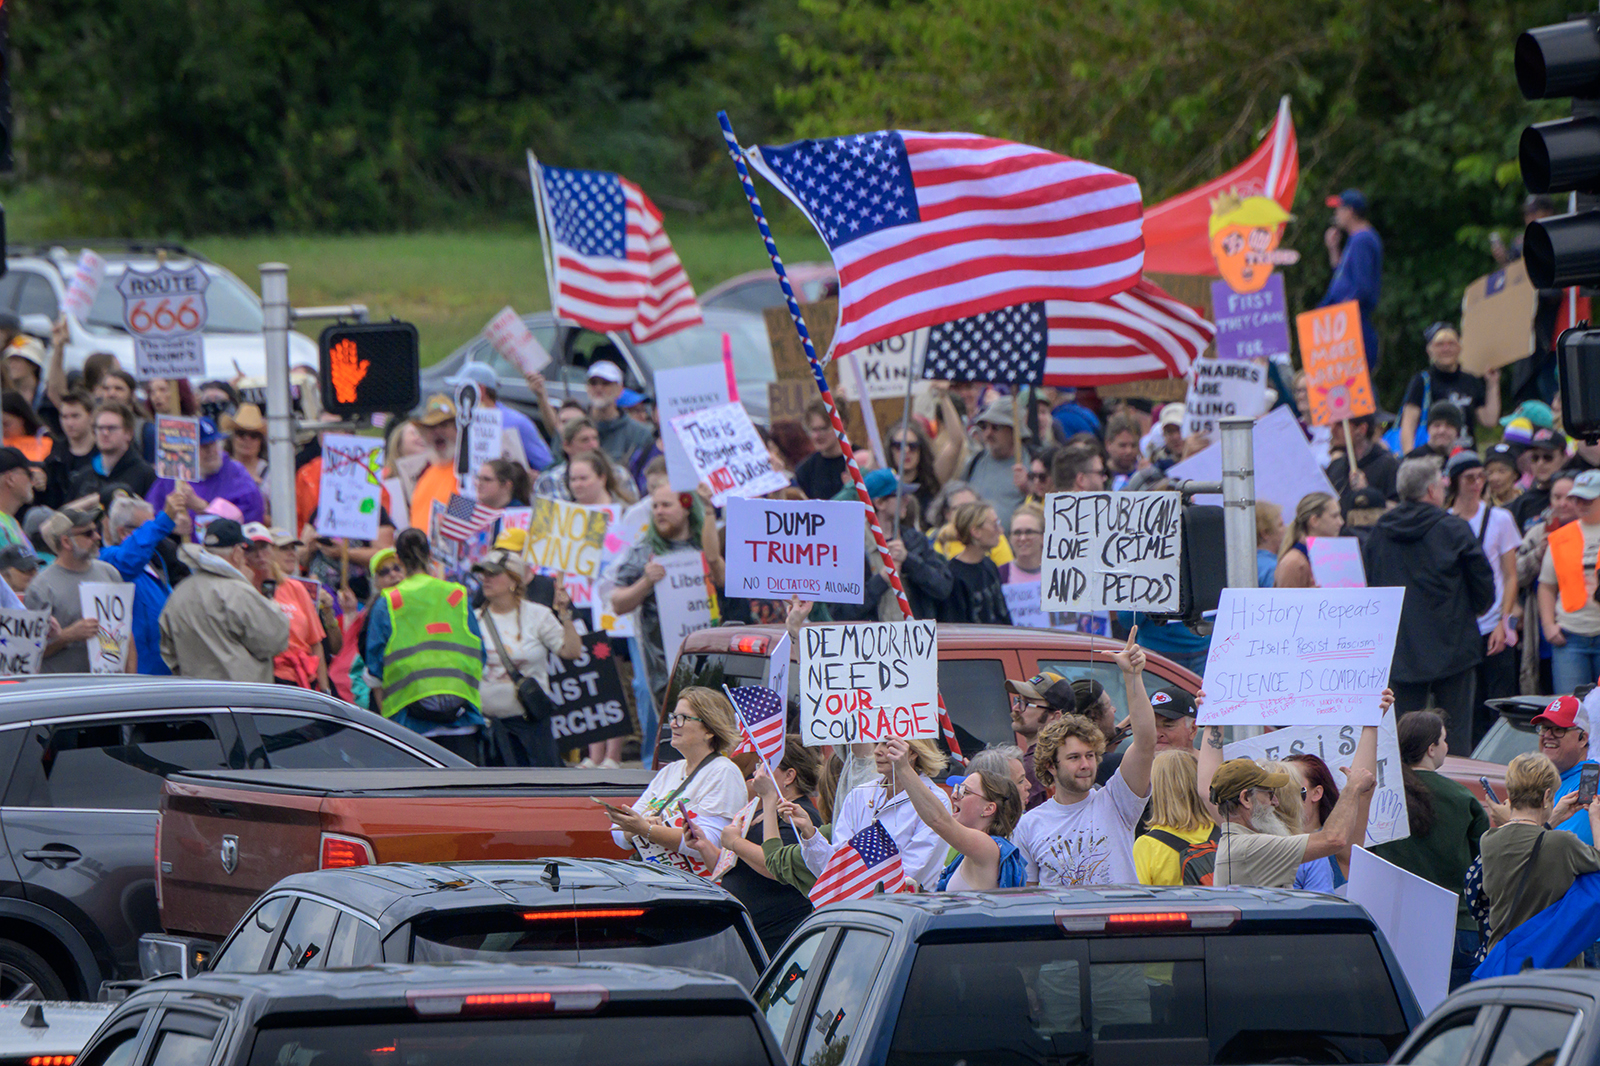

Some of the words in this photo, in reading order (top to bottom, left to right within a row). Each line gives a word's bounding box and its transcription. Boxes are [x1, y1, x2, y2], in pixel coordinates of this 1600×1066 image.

[131, 275, 198, 295] ROUTE
[130, 298, 200, 333] 666
[1228, 291, 1273, 313] FIRST
[1217, 315, 1250, 333] THEY
[1312, 310, 1347, 346] NO
[868, 333, 906, 354] NO
[1310, 338, 1356, 368] MORE
[1198, 363, 1259, 384] NAIRES
[683, 420, 719, 444] This
[1190, 420, 1213, 433] US
[694, 443, 737, 469] Straight
[738, 440, 755, 456] up
[708, 466, 735, 495] NAZI
[550, 502, 588, 541] NO
[764, 510, 826, 537] DUMP
[524, 529, 599, 576] KING
[744, 539, 838, 568] TRUMP!
[1046, 533, 1090, 561] LOVE
[1101, 532, 1175, 568] CRIME
[743, 576, 760, 590] NO
[767, 576, 820, 592] DICTATORS
[824, 580, 861, 596] ALLOWED
[1047, 566, 1087, 605] AND
[1102, 573, 1177, 606] PEDOS
[94, 595, 125, 622] NO
[687, 598, 714, 612] and
[1231, 597, 1304, 637] History
[1318, 599, 1381, 629] Repeats
[806, 623, 936, 660] DEMOCRACY
[1295, 637, 1328, 655] Resist
[550, 672, 600, 706] NST
[808, 659, 909, 691] NEEDS
[1213, 671, 1289, 702] SILENCE
[1298, 669, 1314, 692] IS
[806, 689, 873, 716] YOUR
[1261, 706, 1279, 719] RISE
[1301, 698, 1315, 708] This
[550, 700, 624, 739] RCHS
[811, 702, 936, 742] COURAGE
